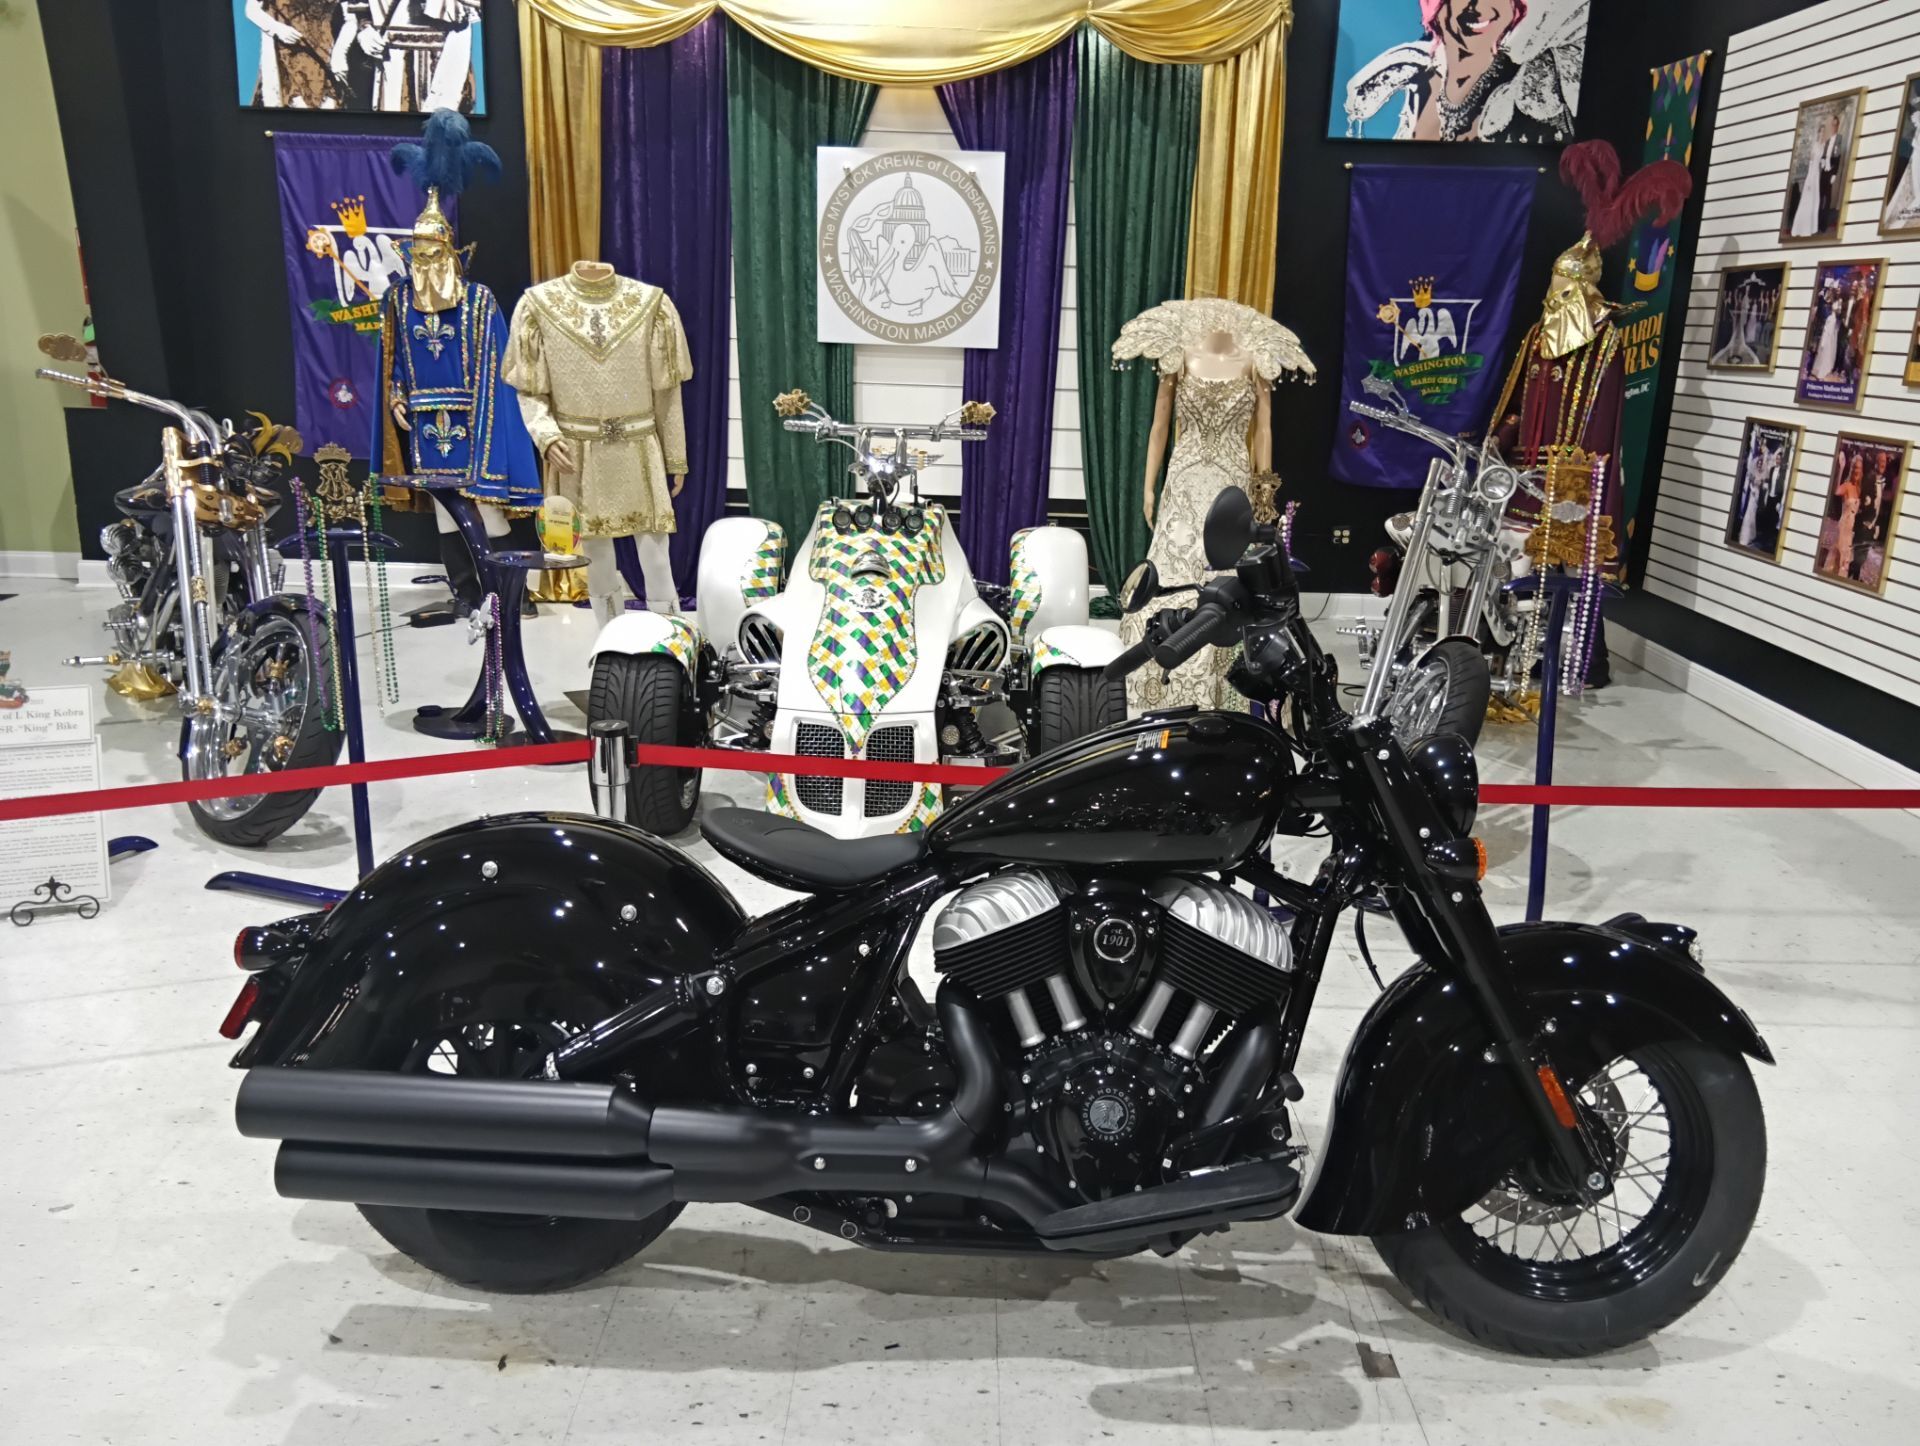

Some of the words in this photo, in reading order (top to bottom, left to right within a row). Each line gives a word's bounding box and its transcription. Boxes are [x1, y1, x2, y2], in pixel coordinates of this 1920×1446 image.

[873, 154, 924, 173] KREWE
[927, 161, 941, 171] of
[827, 169, 874, 220] MYSTICK
[942, 166, 996, 255] LOUISIANIANS
[822, 223, 836, 248] The
[826, 267, 910, 340] WASHINGTON
[914, 314, 962, 340] MARDI
[961, 274, 992, 315] GRAS
[1394, 356, 1467, 377] WASHINGTON
[1623, 338, 1660, 375] RAS
[26, 710, 50, 720] King
[56, 721, 78, 731] Bike
[1102, 934, 1130, 947] 1901
